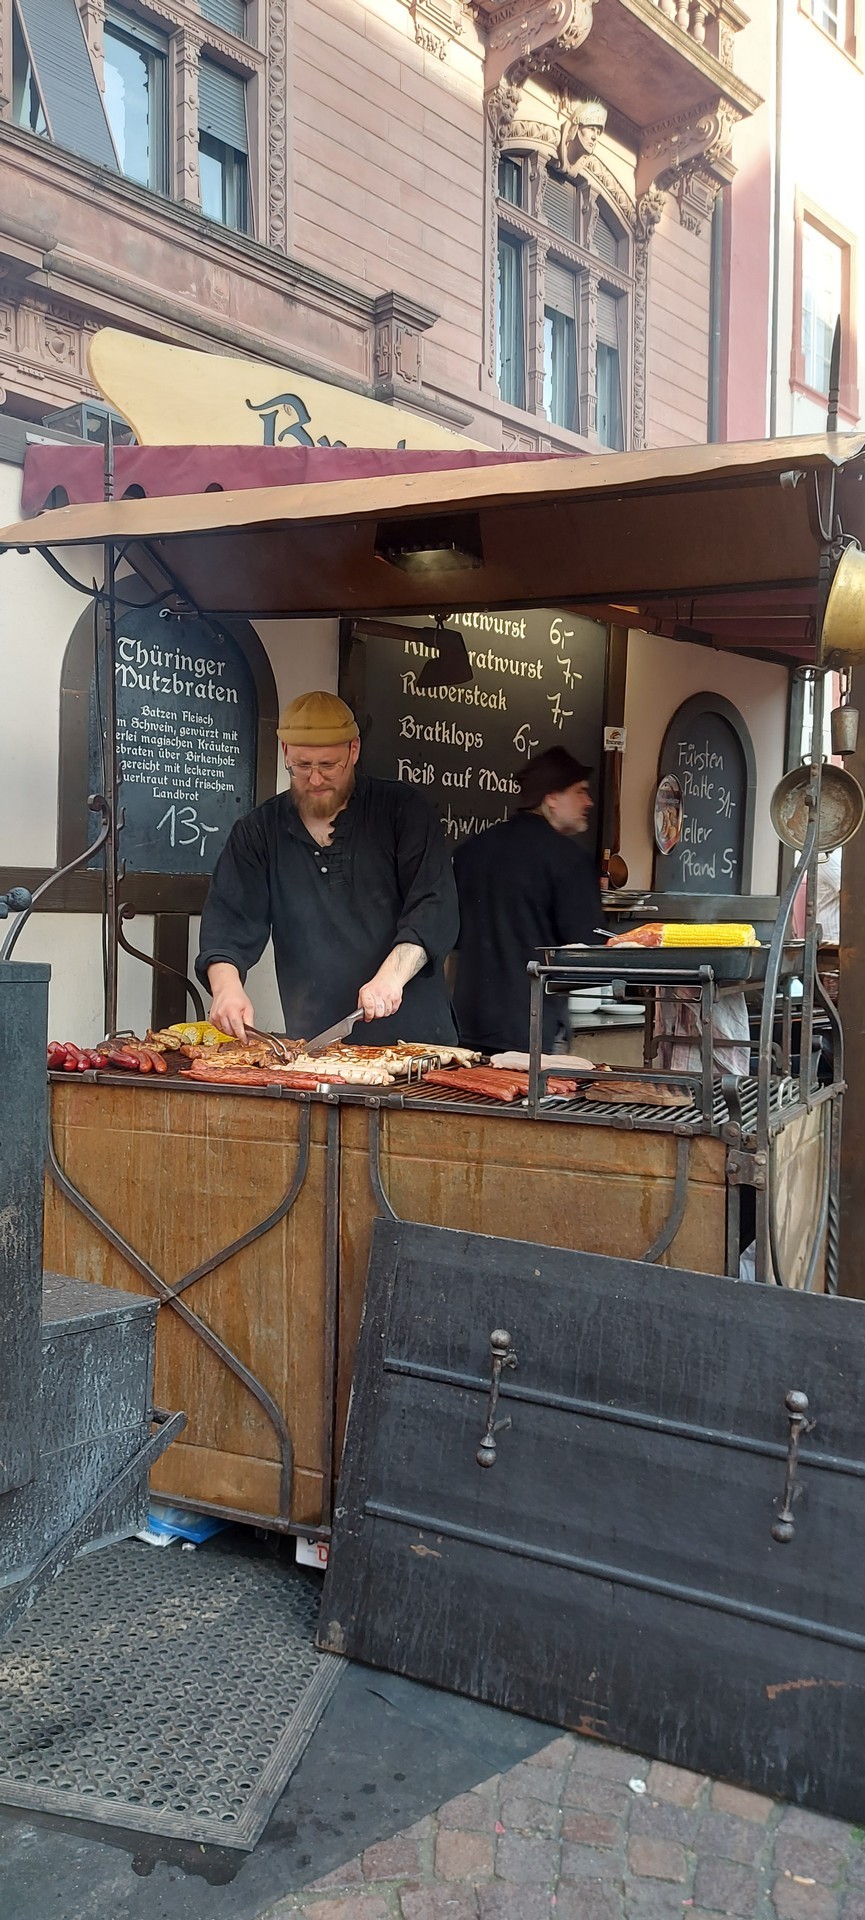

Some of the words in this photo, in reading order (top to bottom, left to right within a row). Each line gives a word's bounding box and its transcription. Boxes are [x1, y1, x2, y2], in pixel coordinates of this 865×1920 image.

[549, 618, 574, 649] 6,-
[117, 637, 225, 678] Thüringer
[556, 654, 583, 689] 7,-
[115, 662, 238, 703] Mutzbraten
[140, 705, 177, 720] Batzen
[182, 711, 214, 727] Fleisch
[547, 692, 574, 730] 7,-
[131, 717, 177, 736] Schwein,
[179, 726, 219, 740] gewürzt
[222, 730, 239, 741] mit
[141, 734, 193, 752] magischen
[197, 739, 240, 754] Kräutern
[399, 714, 484, 752] Bratklops
[512, 723, 540, 760] 6,-
[116, 743, 154, 757] ebraten
[158, 749, 180, 760] über
[185, 751, 236, 767] Birkenholz
[678, 740, 724, 770] Fürsten
[122, 773, 168, 787] uerkraut
[172, 778, 191, 788] und
[195, 780, 235, 793] frischem
[164, 763, 181, 774] mit
[184, 764, 225, 778] leckerem
[398, 758, 435, 785] Heiß
[441, 767, 472, 788] auf
[478, 768, 522, 795] Mais
[682, 771, 714, 800] Platte
[153, 786, 200, 801] Landbrot
[156, 804, 220, 857] 13,-
[679, 849, 716, 883] Pfand
